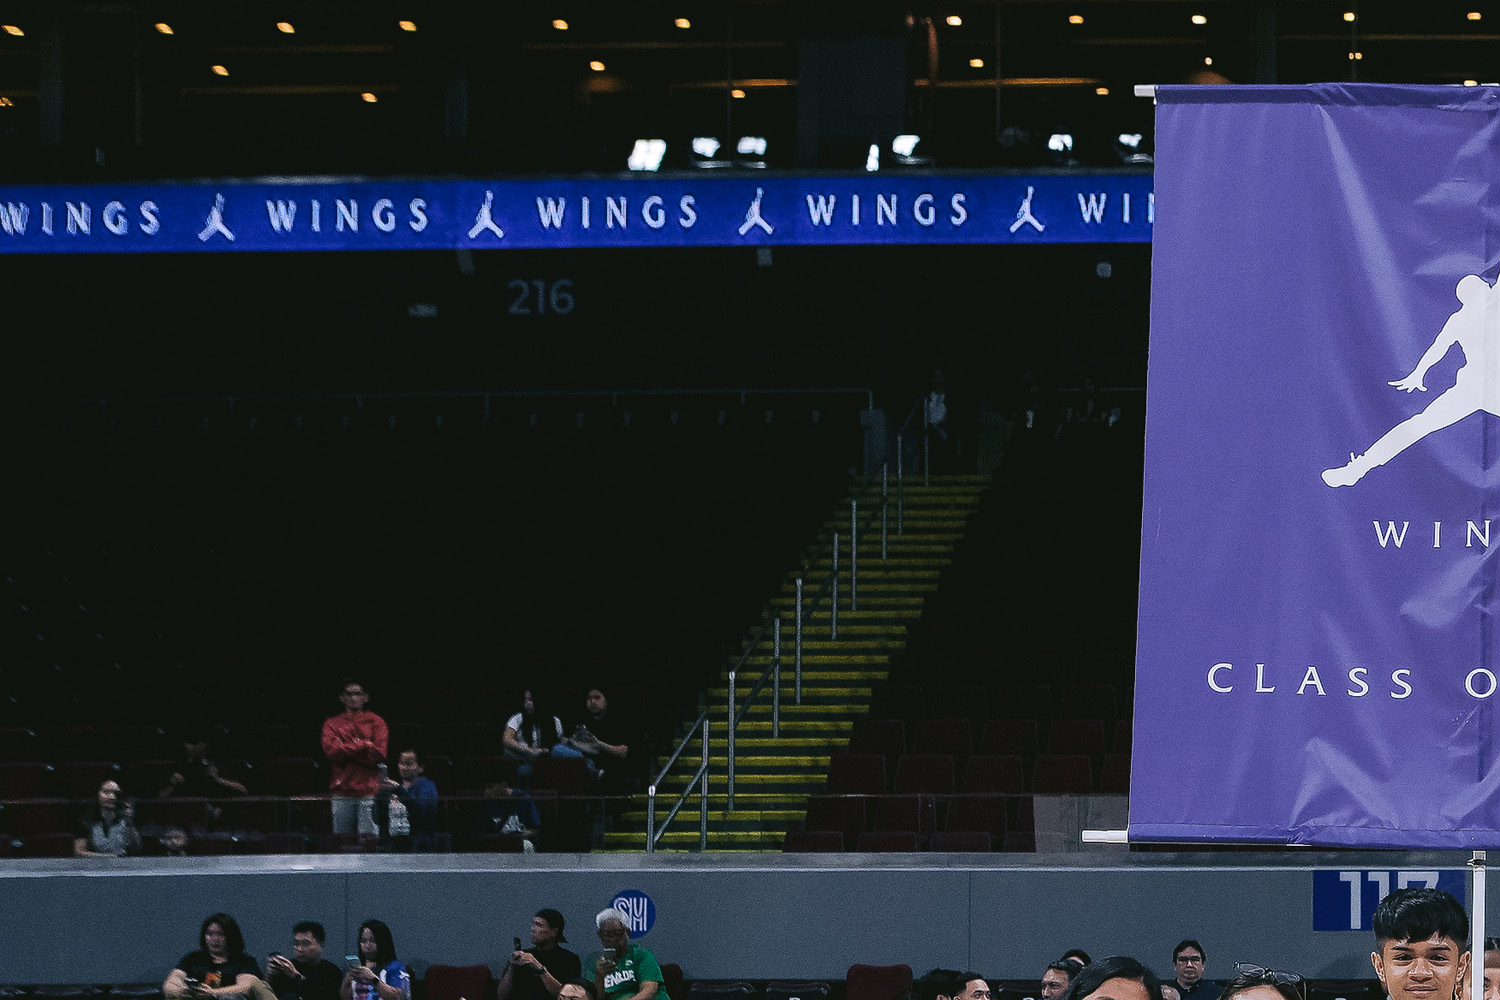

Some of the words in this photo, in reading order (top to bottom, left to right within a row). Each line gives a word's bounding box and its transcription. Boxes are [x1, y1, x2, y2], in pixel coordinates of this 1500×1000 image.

[0, 200, 160, 235] WINGS
[266, 198, 428, 232] WINGS
[536, 195, 697, 229] WINGS
[806, 193, 968, 226] WINGS
[1077, 192, 1154, 224] WI
[507, 278, 575, 315] 216
[1207, 662, 1413, 699] CLASS
